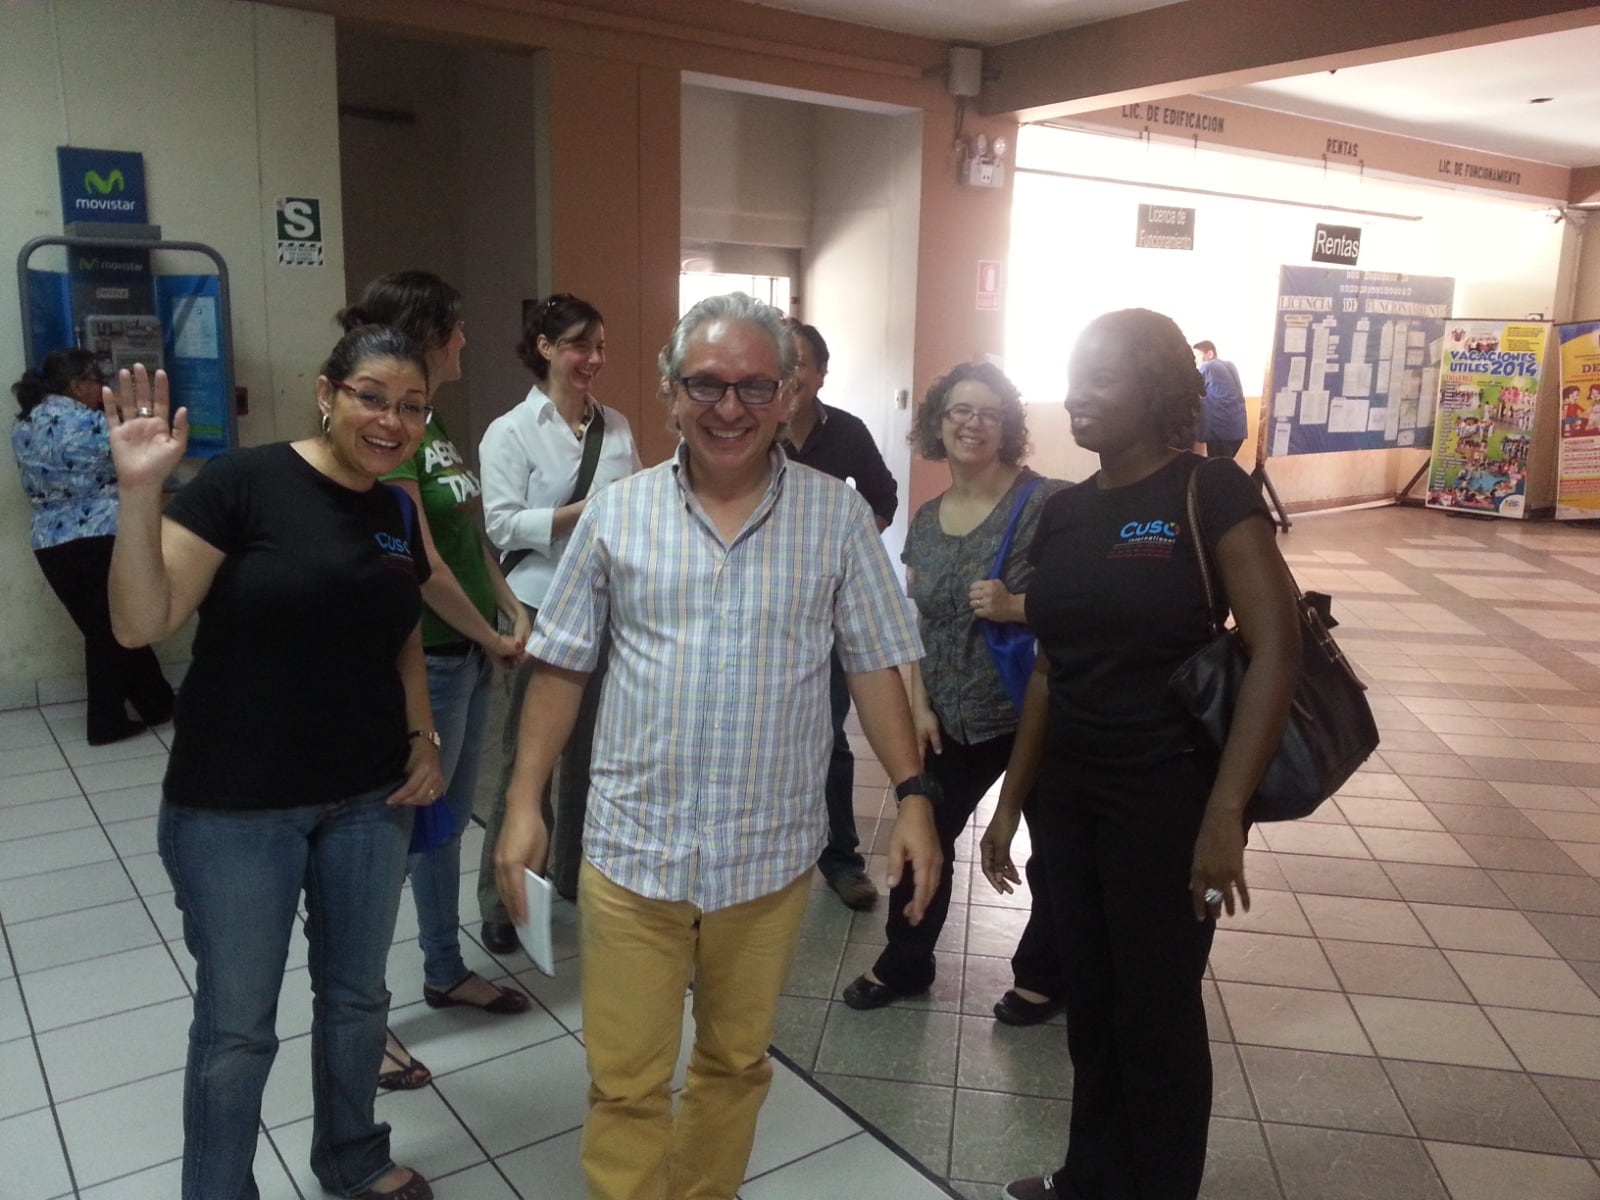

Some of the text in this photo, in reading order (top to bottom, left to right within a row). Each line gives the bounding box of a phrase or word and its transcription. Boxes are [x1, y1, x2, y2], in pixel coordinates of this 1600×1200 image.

[1147, 105, 1160, 122] DE
[1163, 107, 1225, 134] EDIFICACION
[1326, 138, 1359, 158] RENTAS
[1454, 163, 1464, 177] DE
[1465, 164, 1521, 185] FUNCIONAMIENTO
[75, 198, 136, 211] movistar
[1148, 204, 1187, 225] Licencia de
[283, 201, 314, 238] S
[1315, 229, 1359, 259] Rentas
[101, 261, 143, 272] movistar
[1280, 296, 1333, 311] LICENCIA
[1343, 297, 1358, 312] DE
[1450, 351, 1537, 363] VACACIONES
[1450, 360, 1537, 377] UTILES 2014
